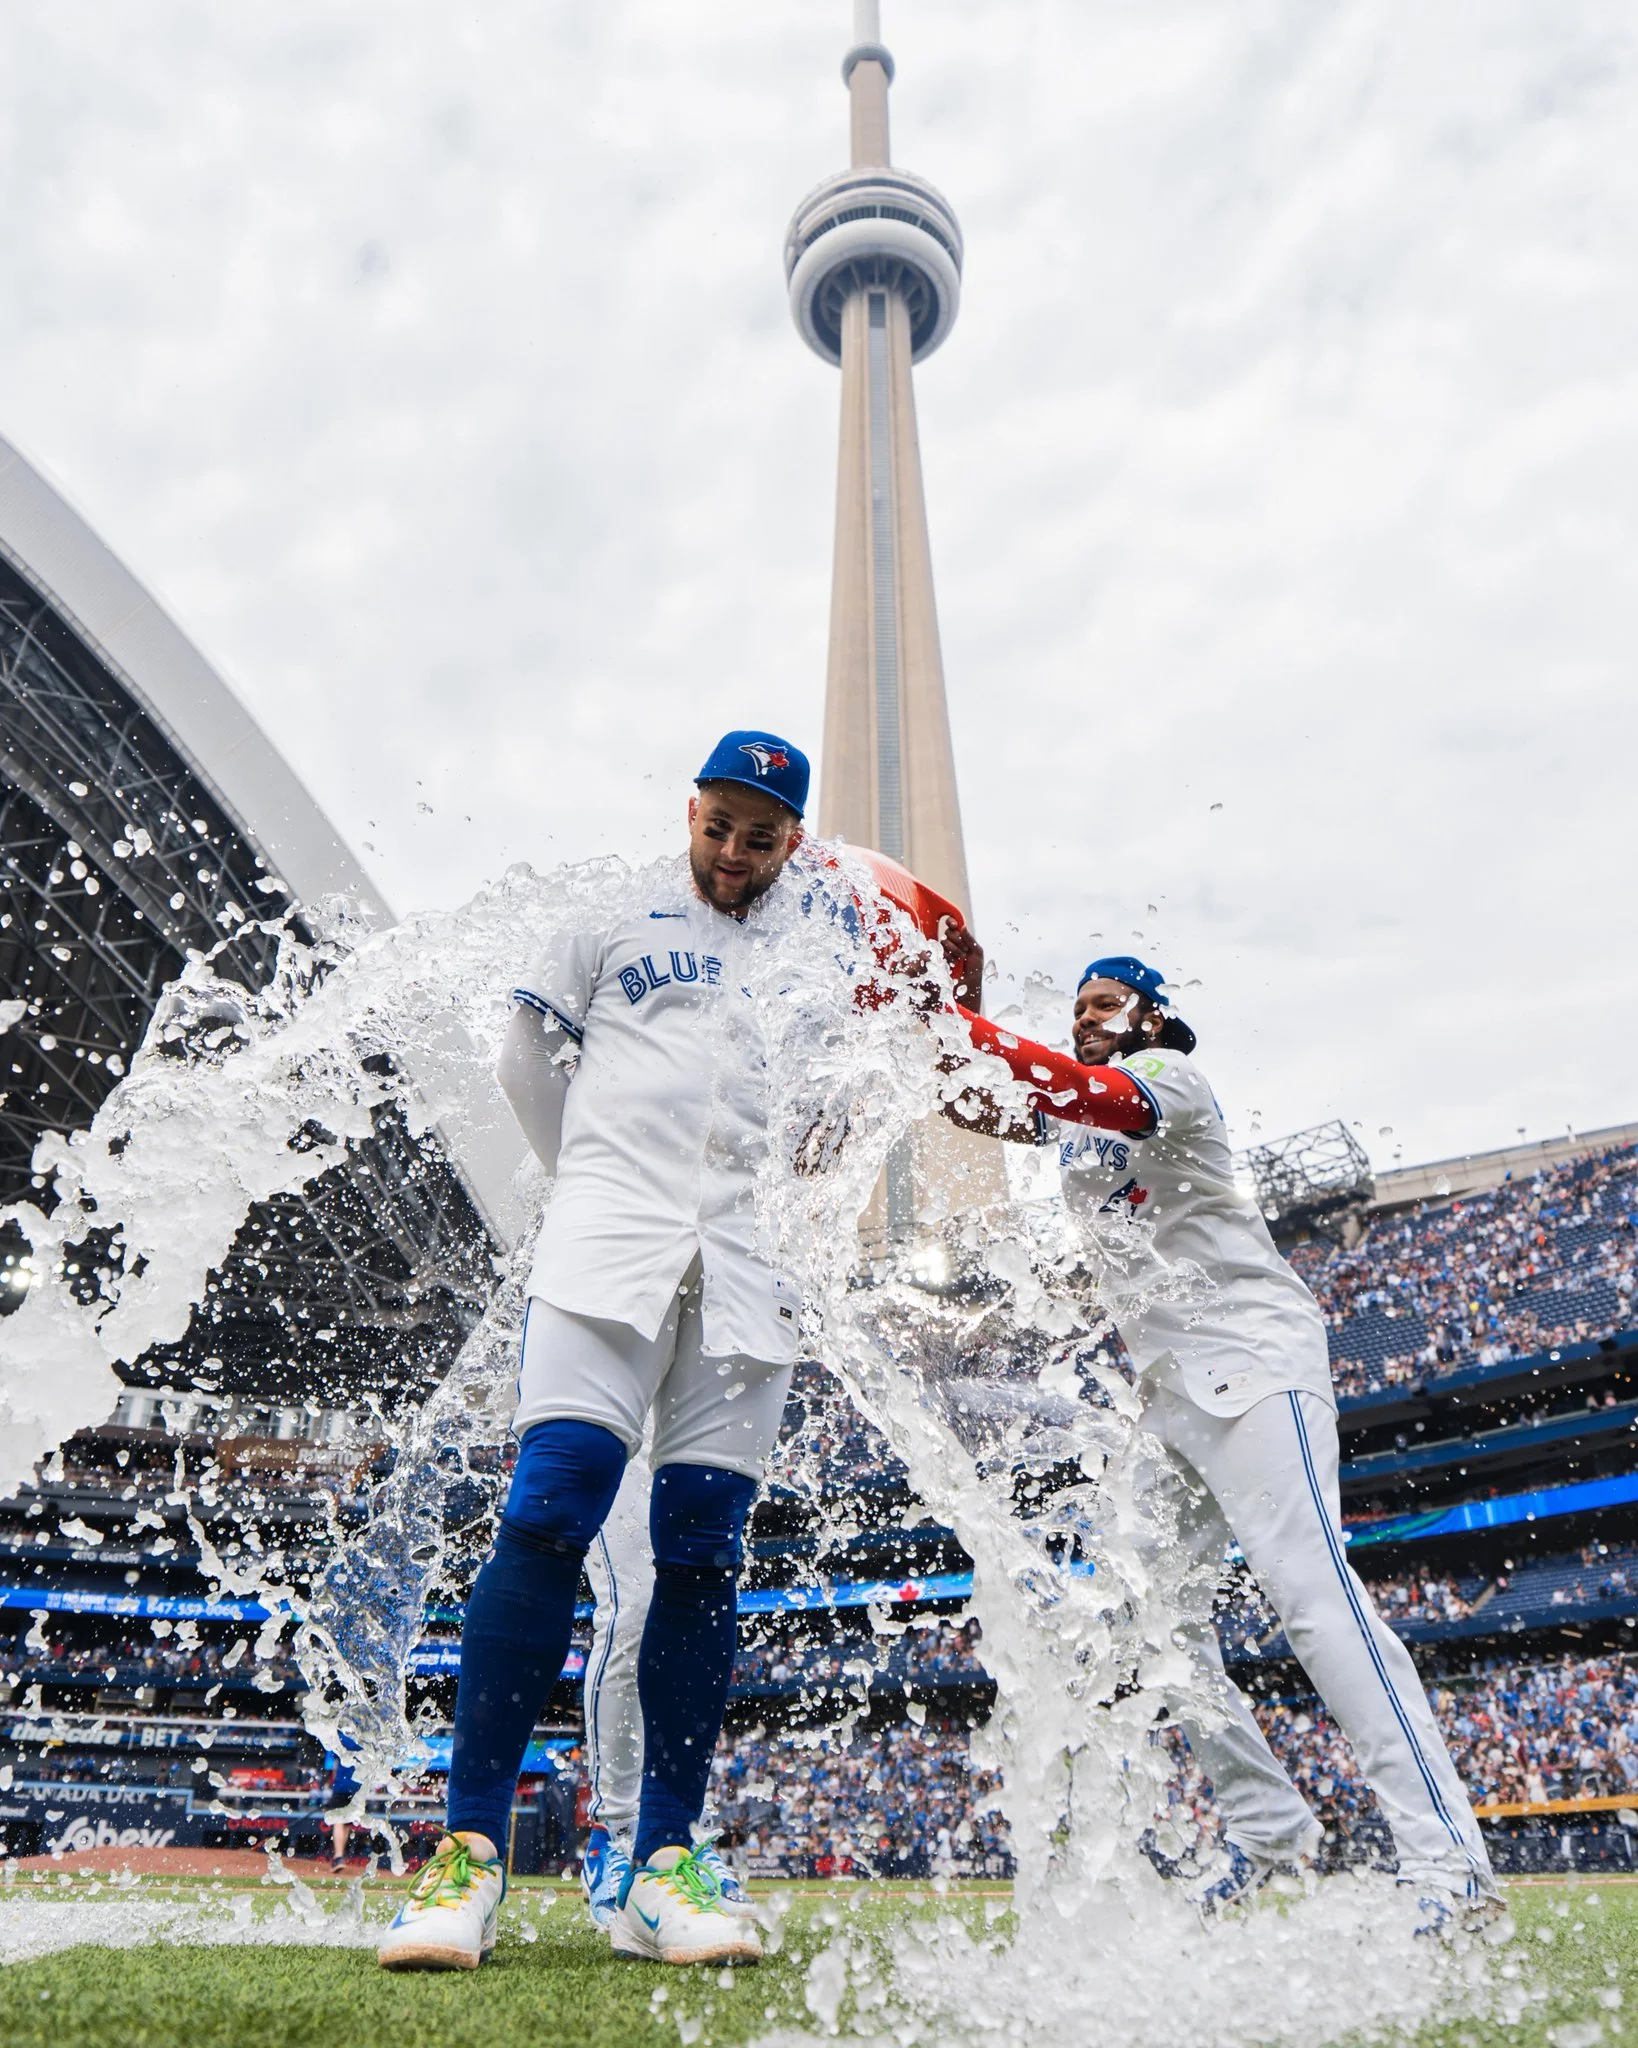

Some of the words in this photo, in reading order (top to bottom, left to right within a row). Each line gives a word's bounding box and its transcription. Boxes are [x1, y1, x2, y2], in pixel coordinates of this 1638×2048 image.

[618, 951, 722, 1006] BLUE
[10, 1720, 123, 1745] theScore
[140, 1727, 183, 1748] BET
